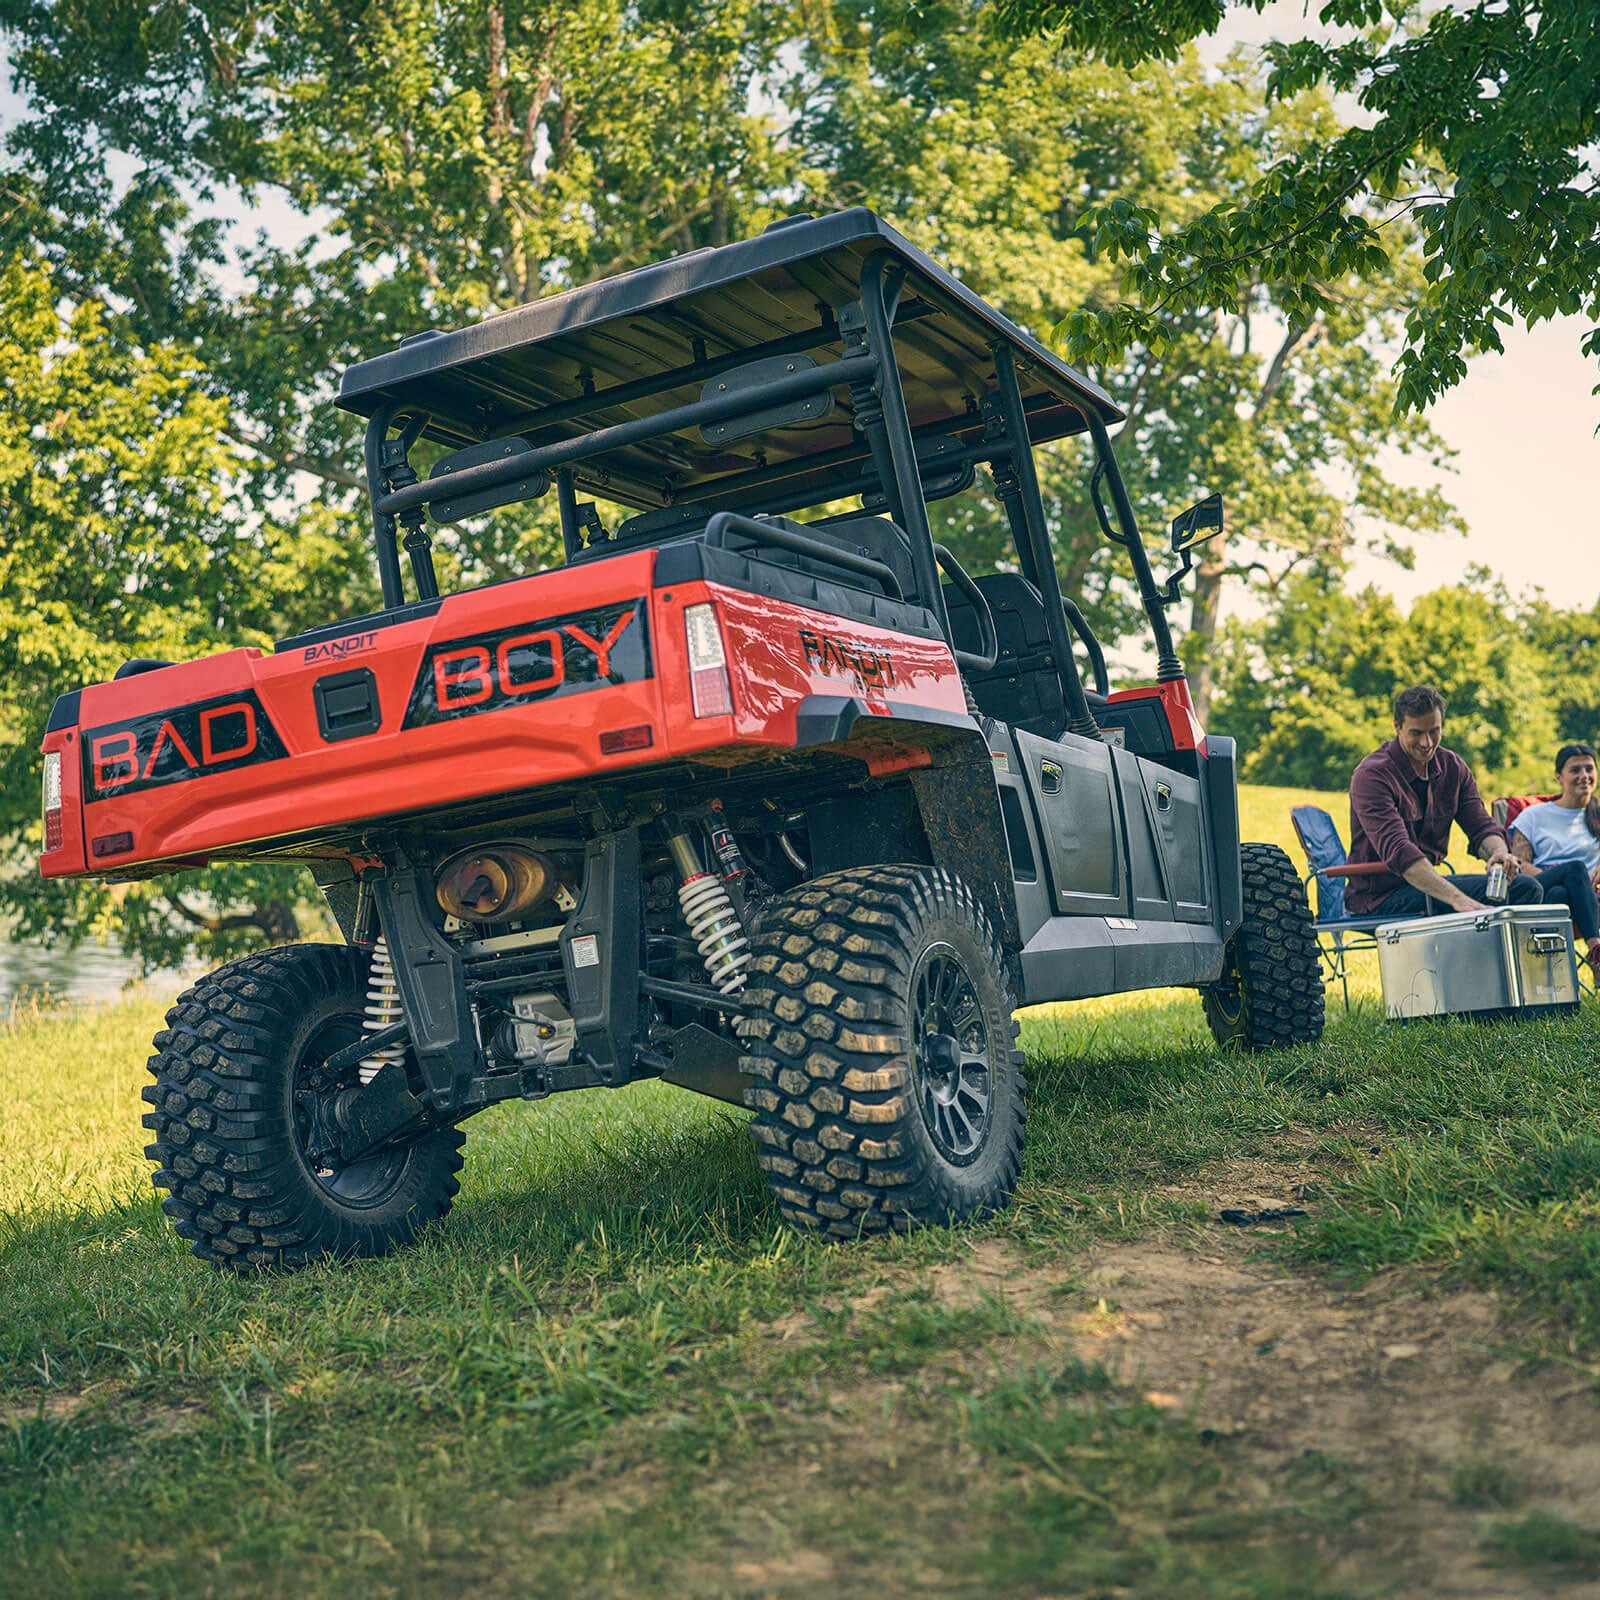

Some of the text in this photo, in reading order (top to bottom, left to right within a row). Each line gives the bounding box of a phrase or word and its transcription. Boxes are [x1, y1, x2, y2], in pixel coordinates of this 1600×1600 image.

[304, 632, 378, 661] BANDIT
[92, 611, 637, 791] BAD BOY
